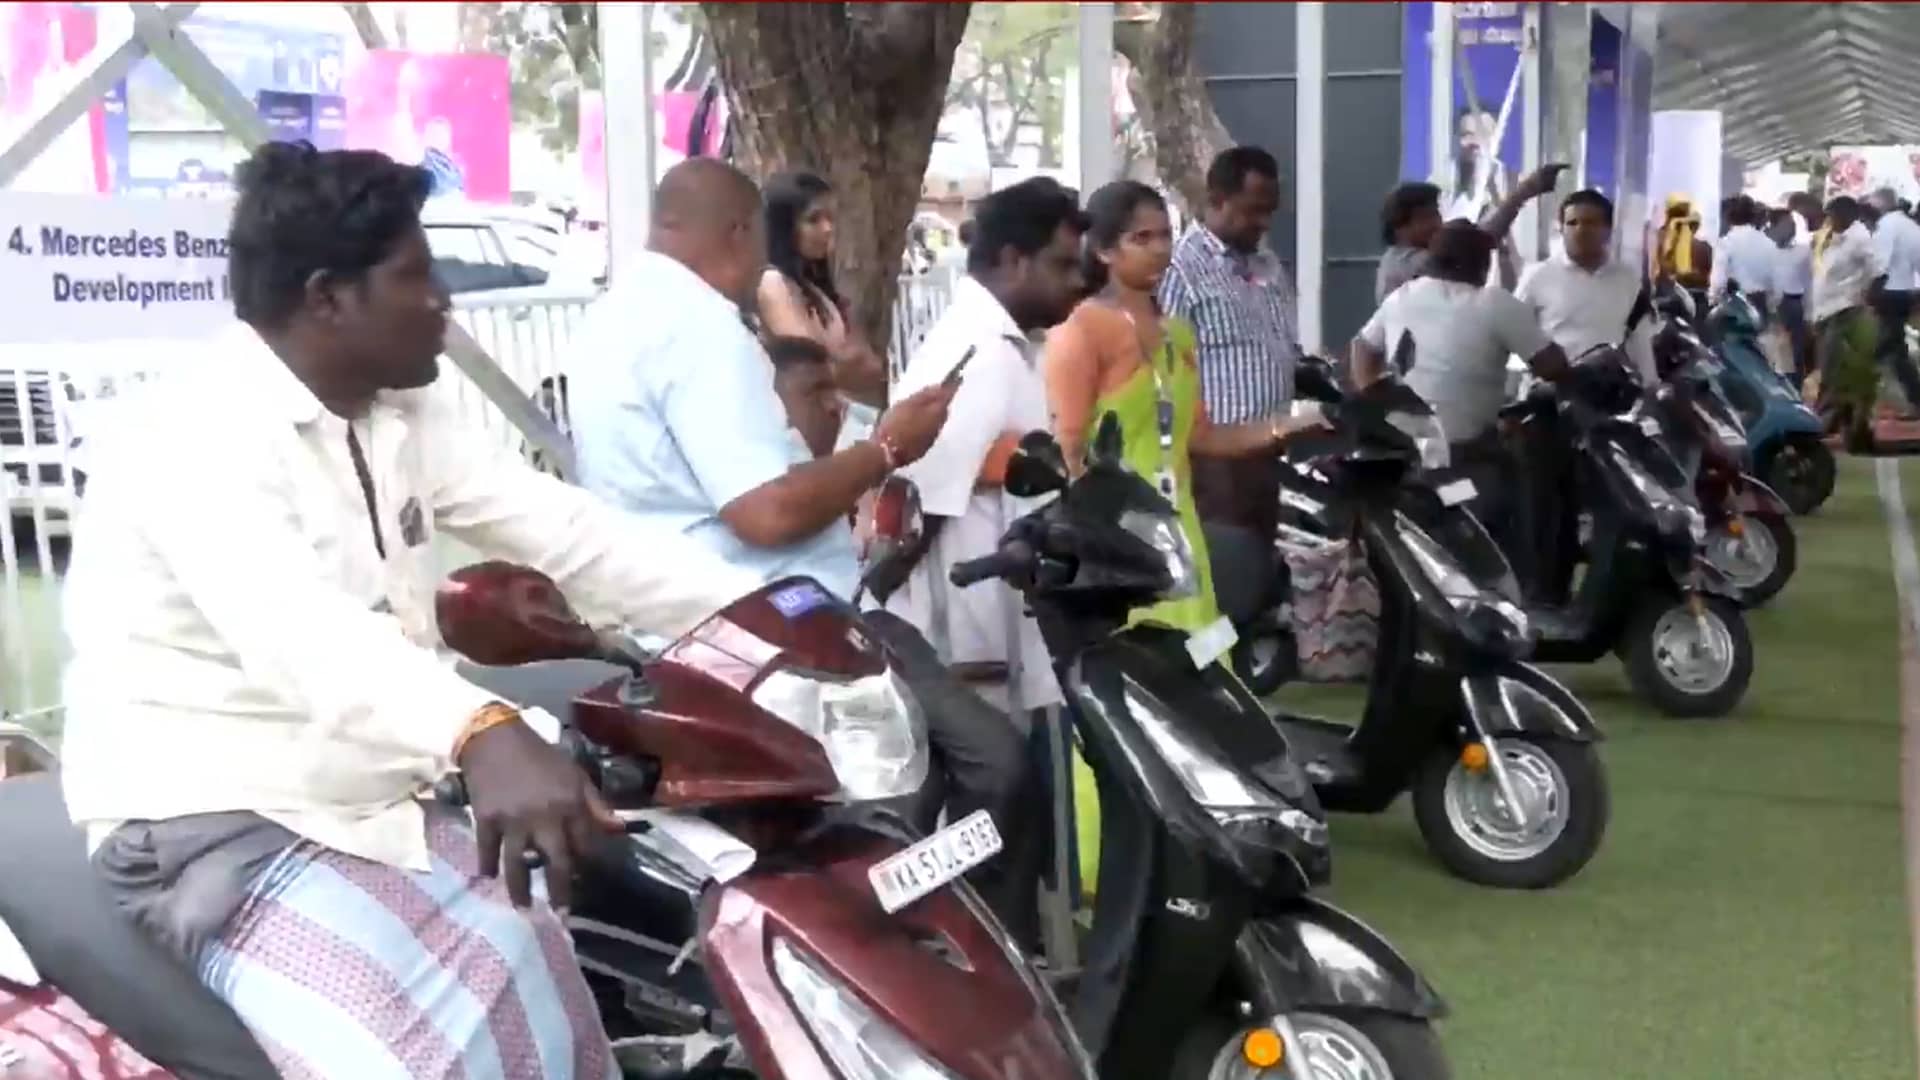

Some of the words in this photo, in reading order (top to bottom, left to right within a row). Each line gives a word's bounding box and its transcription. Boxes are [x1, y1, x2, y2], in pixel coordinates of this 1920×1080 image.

[8, 225, 33, 255] 4.
[40, 226, 167, 258] Mercedes
[53, 272, 215, 309] Development
